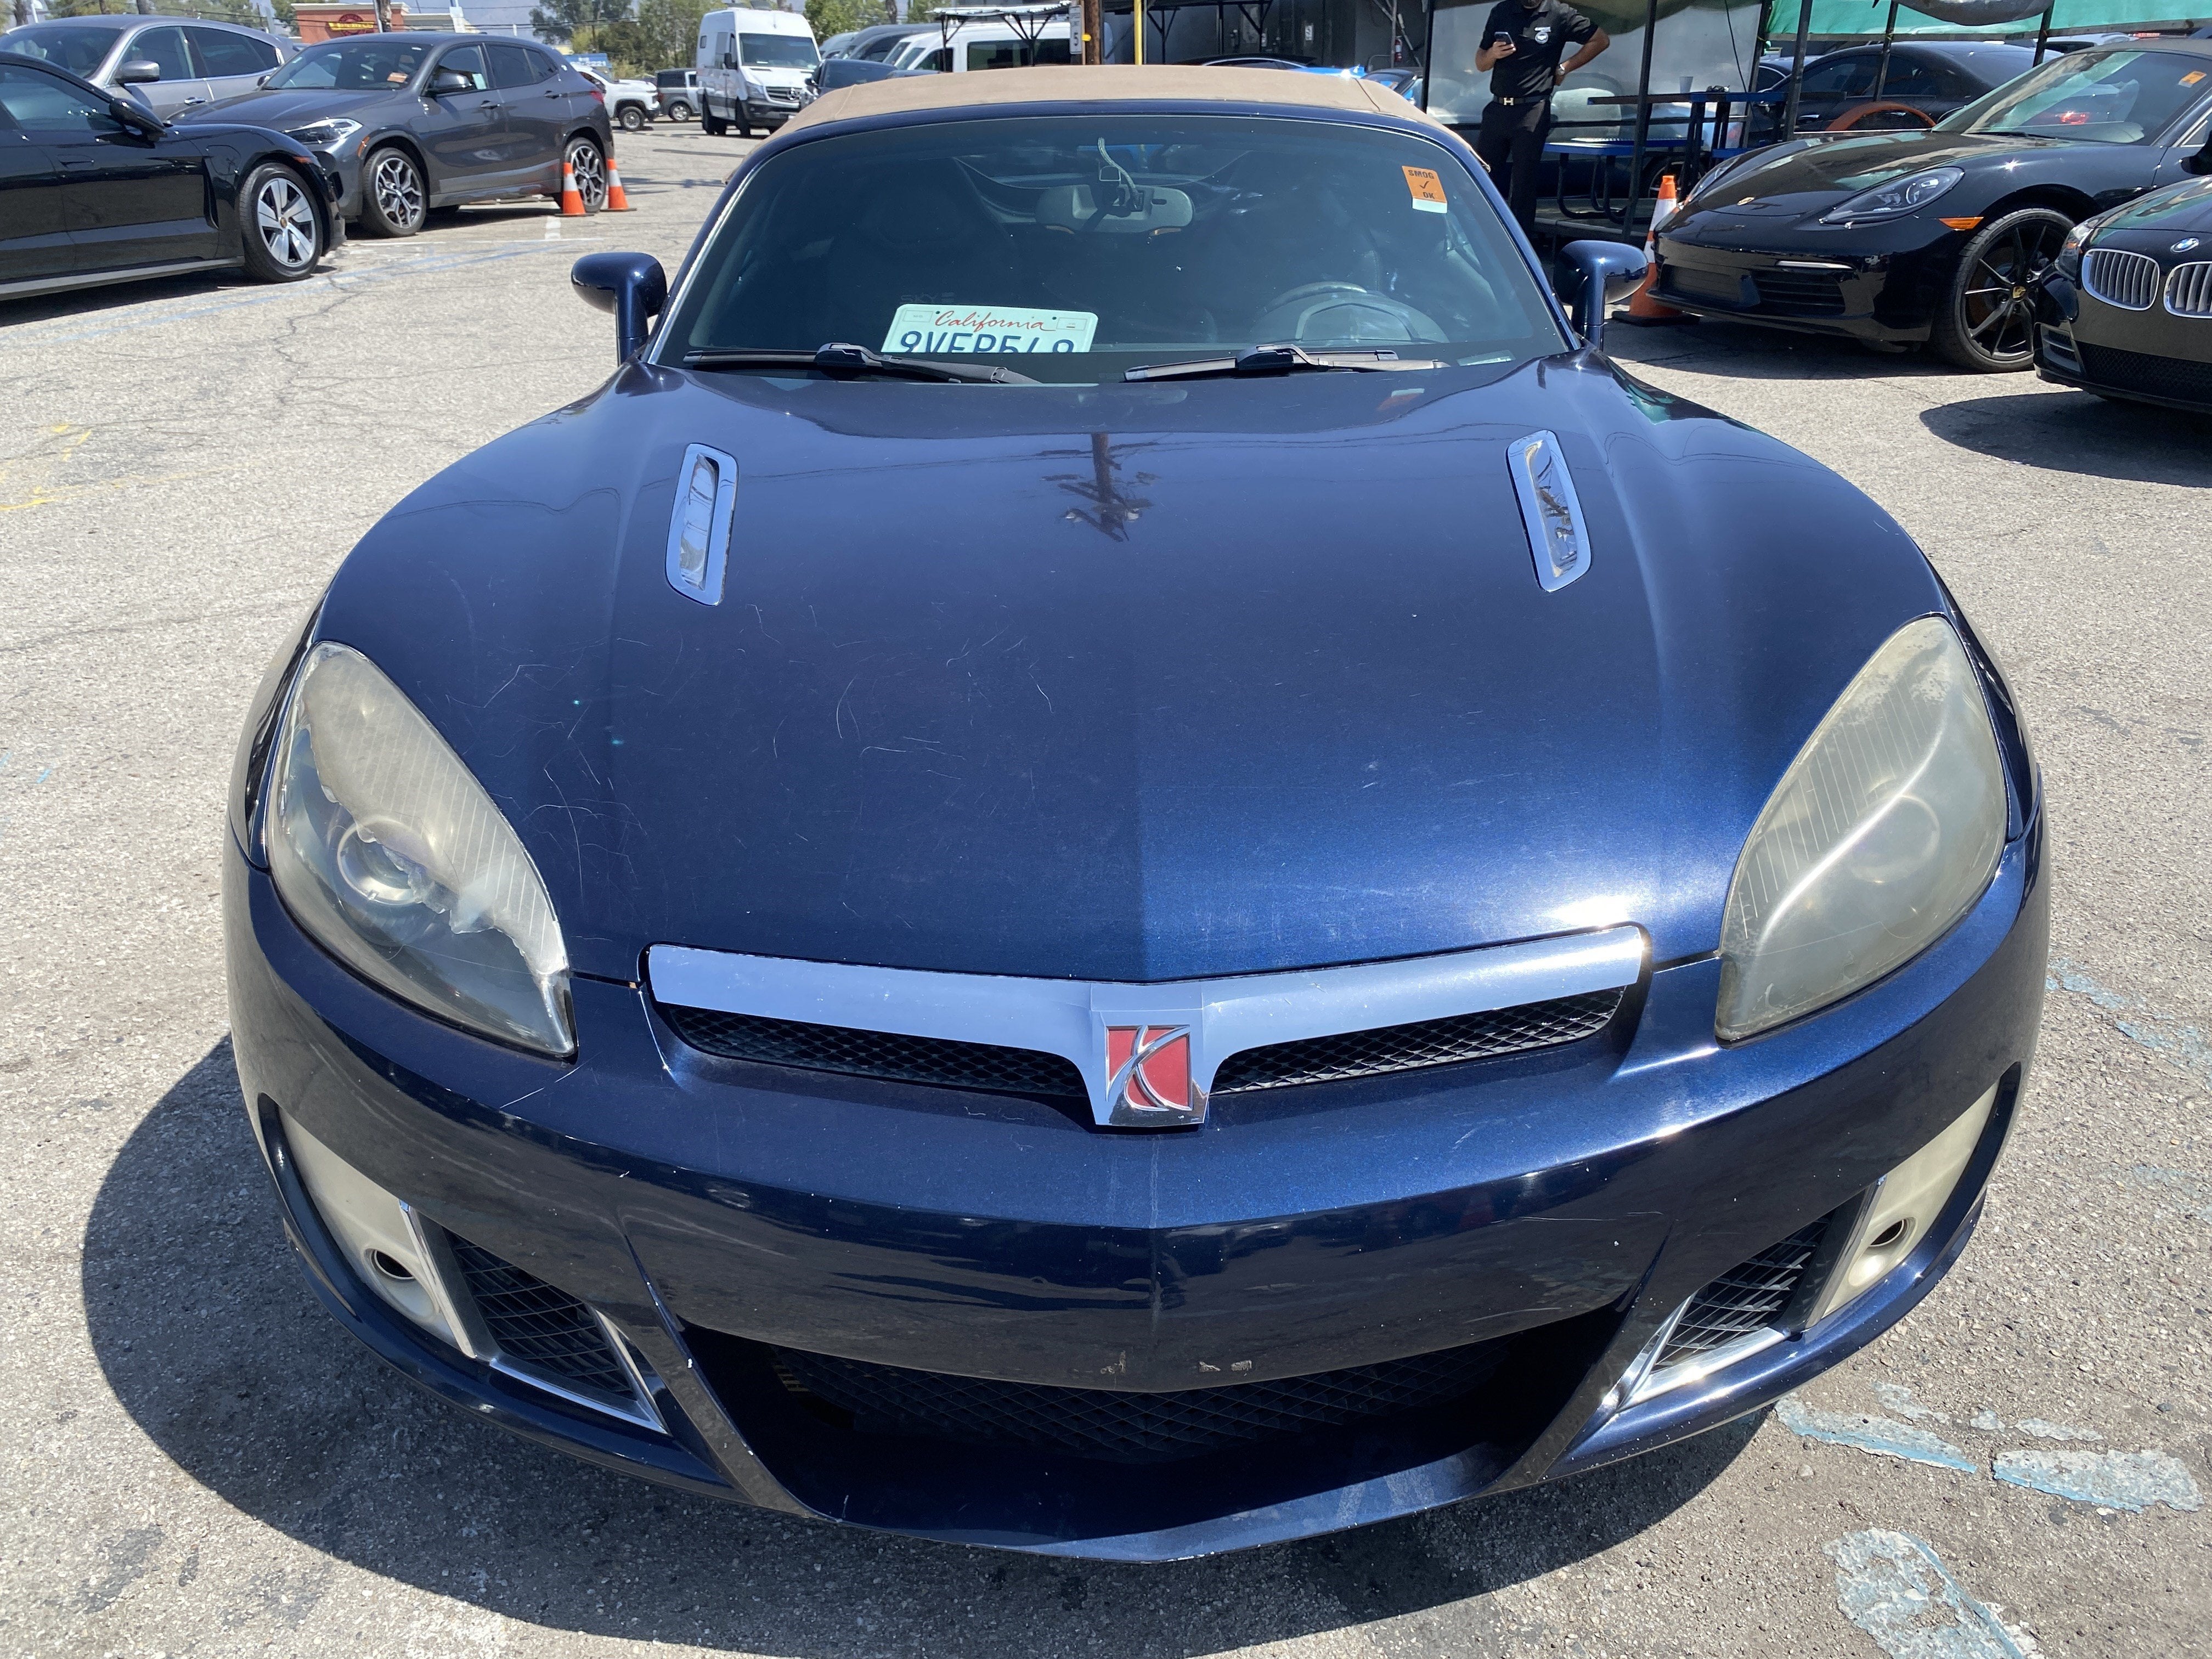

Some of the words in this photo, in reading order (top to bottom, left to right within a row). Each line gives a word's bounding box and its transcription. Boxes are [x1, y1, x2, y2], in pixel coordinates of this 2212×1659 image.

[1074, 32, 1079, 46] 5
[1408, 170, 1435, 179] SMOG
[935, 310, 1056, 333] California
